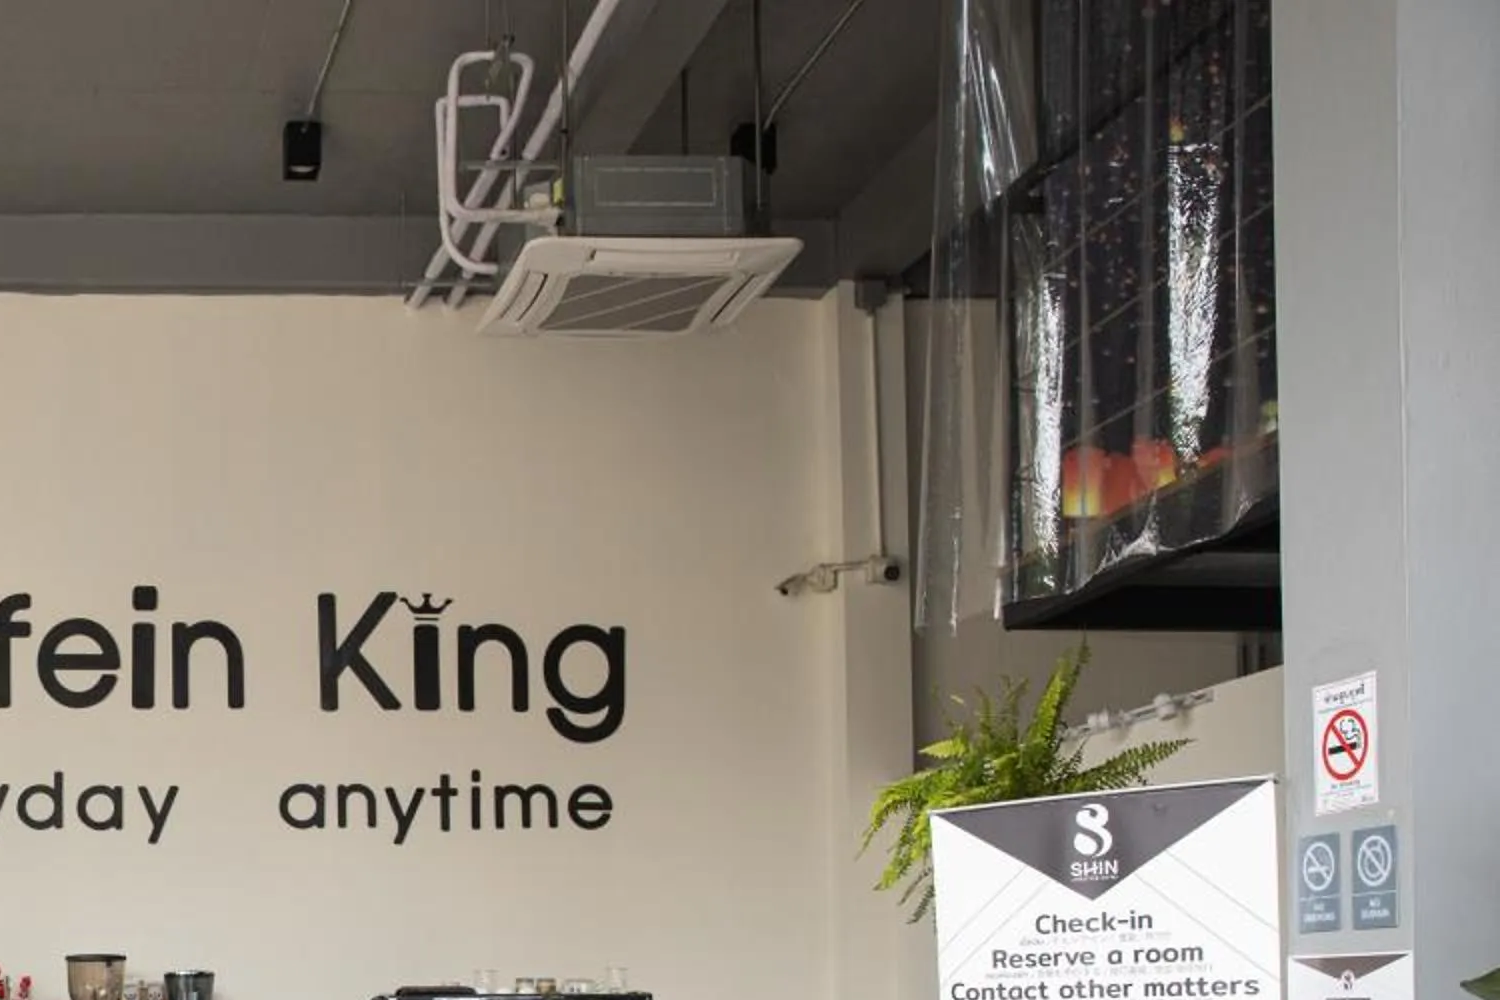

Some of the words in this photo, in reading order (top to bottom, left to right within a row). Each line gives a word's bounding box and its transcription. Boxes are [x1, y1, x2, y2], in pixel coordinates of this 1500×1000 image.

[317, 591, 626, 743] King
[279, 769, 613, 845] anytime
[1070, 859, 1119, 877] SHIN
[1034, 910, 1154, 935] Check-in
[991, 949, 1096, 969] Reserve
[1107, 949, 1123, 965] a
[1133, 946, 1204, 964] room
[1059, 979, 1133, 999] other
[1143, 976, 1260, 998] matters
